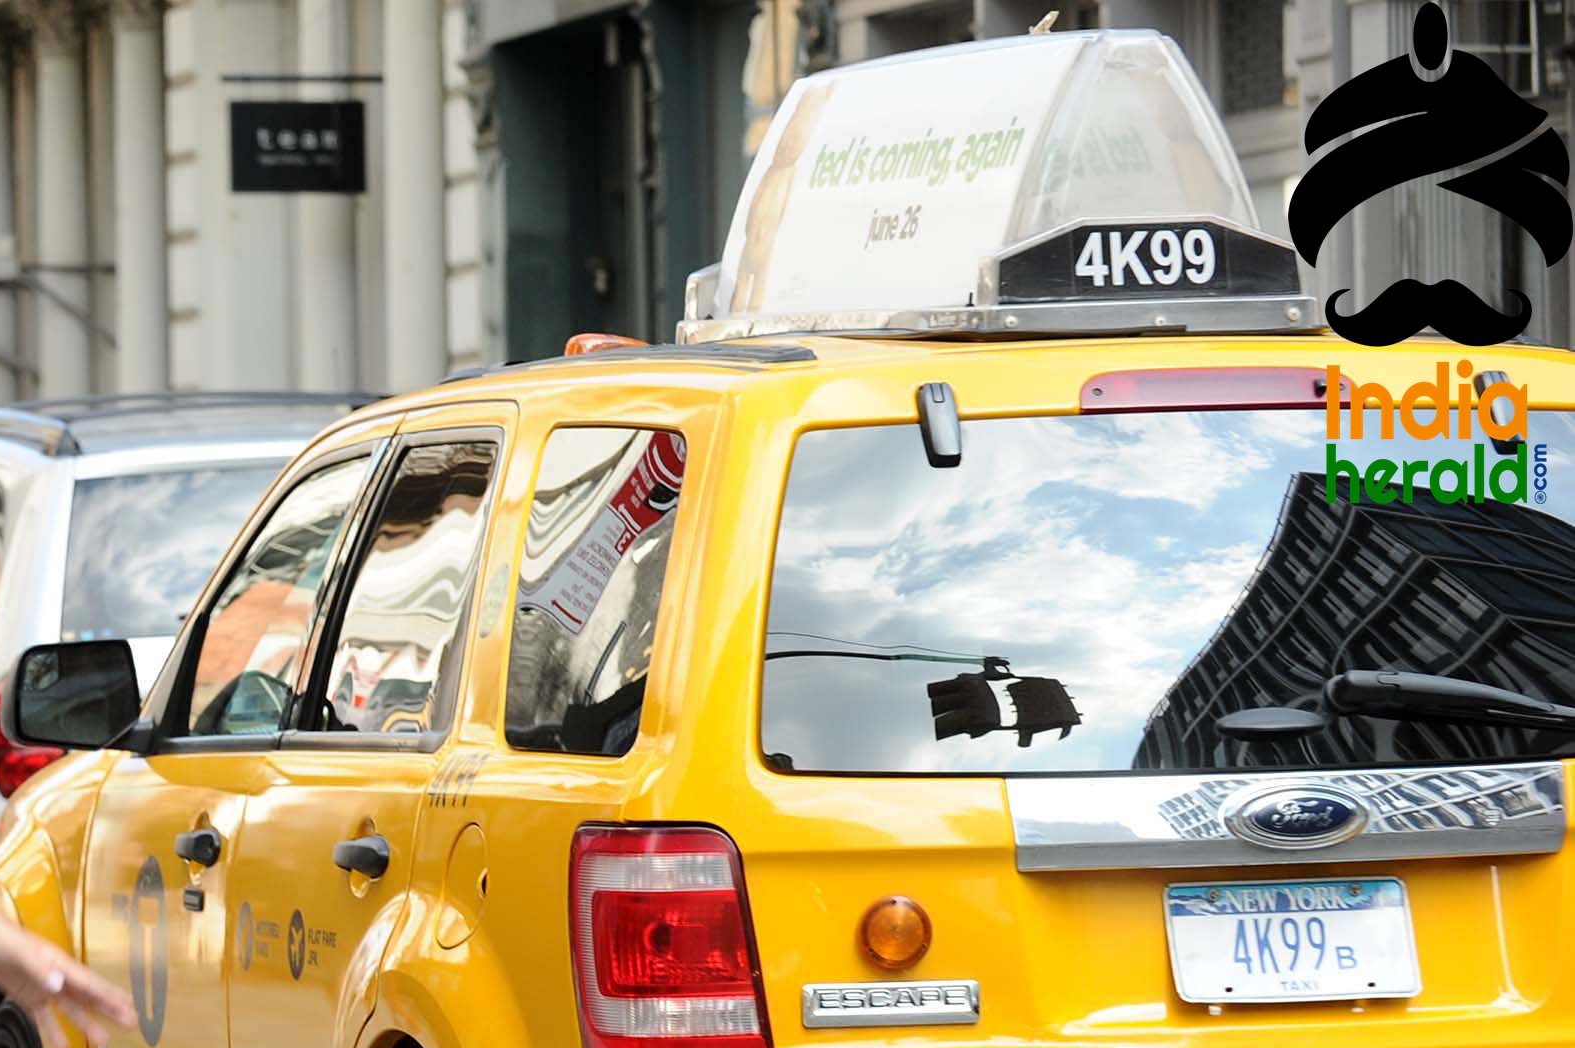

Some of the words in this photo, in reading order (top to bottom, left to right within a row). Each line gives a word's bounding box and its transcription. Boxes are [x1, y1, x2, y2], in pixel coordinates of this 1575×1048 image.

[810, 137, 856, 189] ted
[846, 136, 871, 184] is
[954, 116, 1025, 183] again
[864, 208, 899, 250] june
[899, 205, 922, 240] 26
[1075, 229, 1216, 287] 4K99
[1271, 799, 1334, 829] Ford
[1225, 889, 1288, 913] NEW
[1286, 886, 1348, 911] YORK
[1233, 917, 1327, 975] 4K99
[1334, 946, 1358, 970] B
[814, 984, 970, 1010] ESCAPE
[1279, 979, 1321, 992] TAXI
